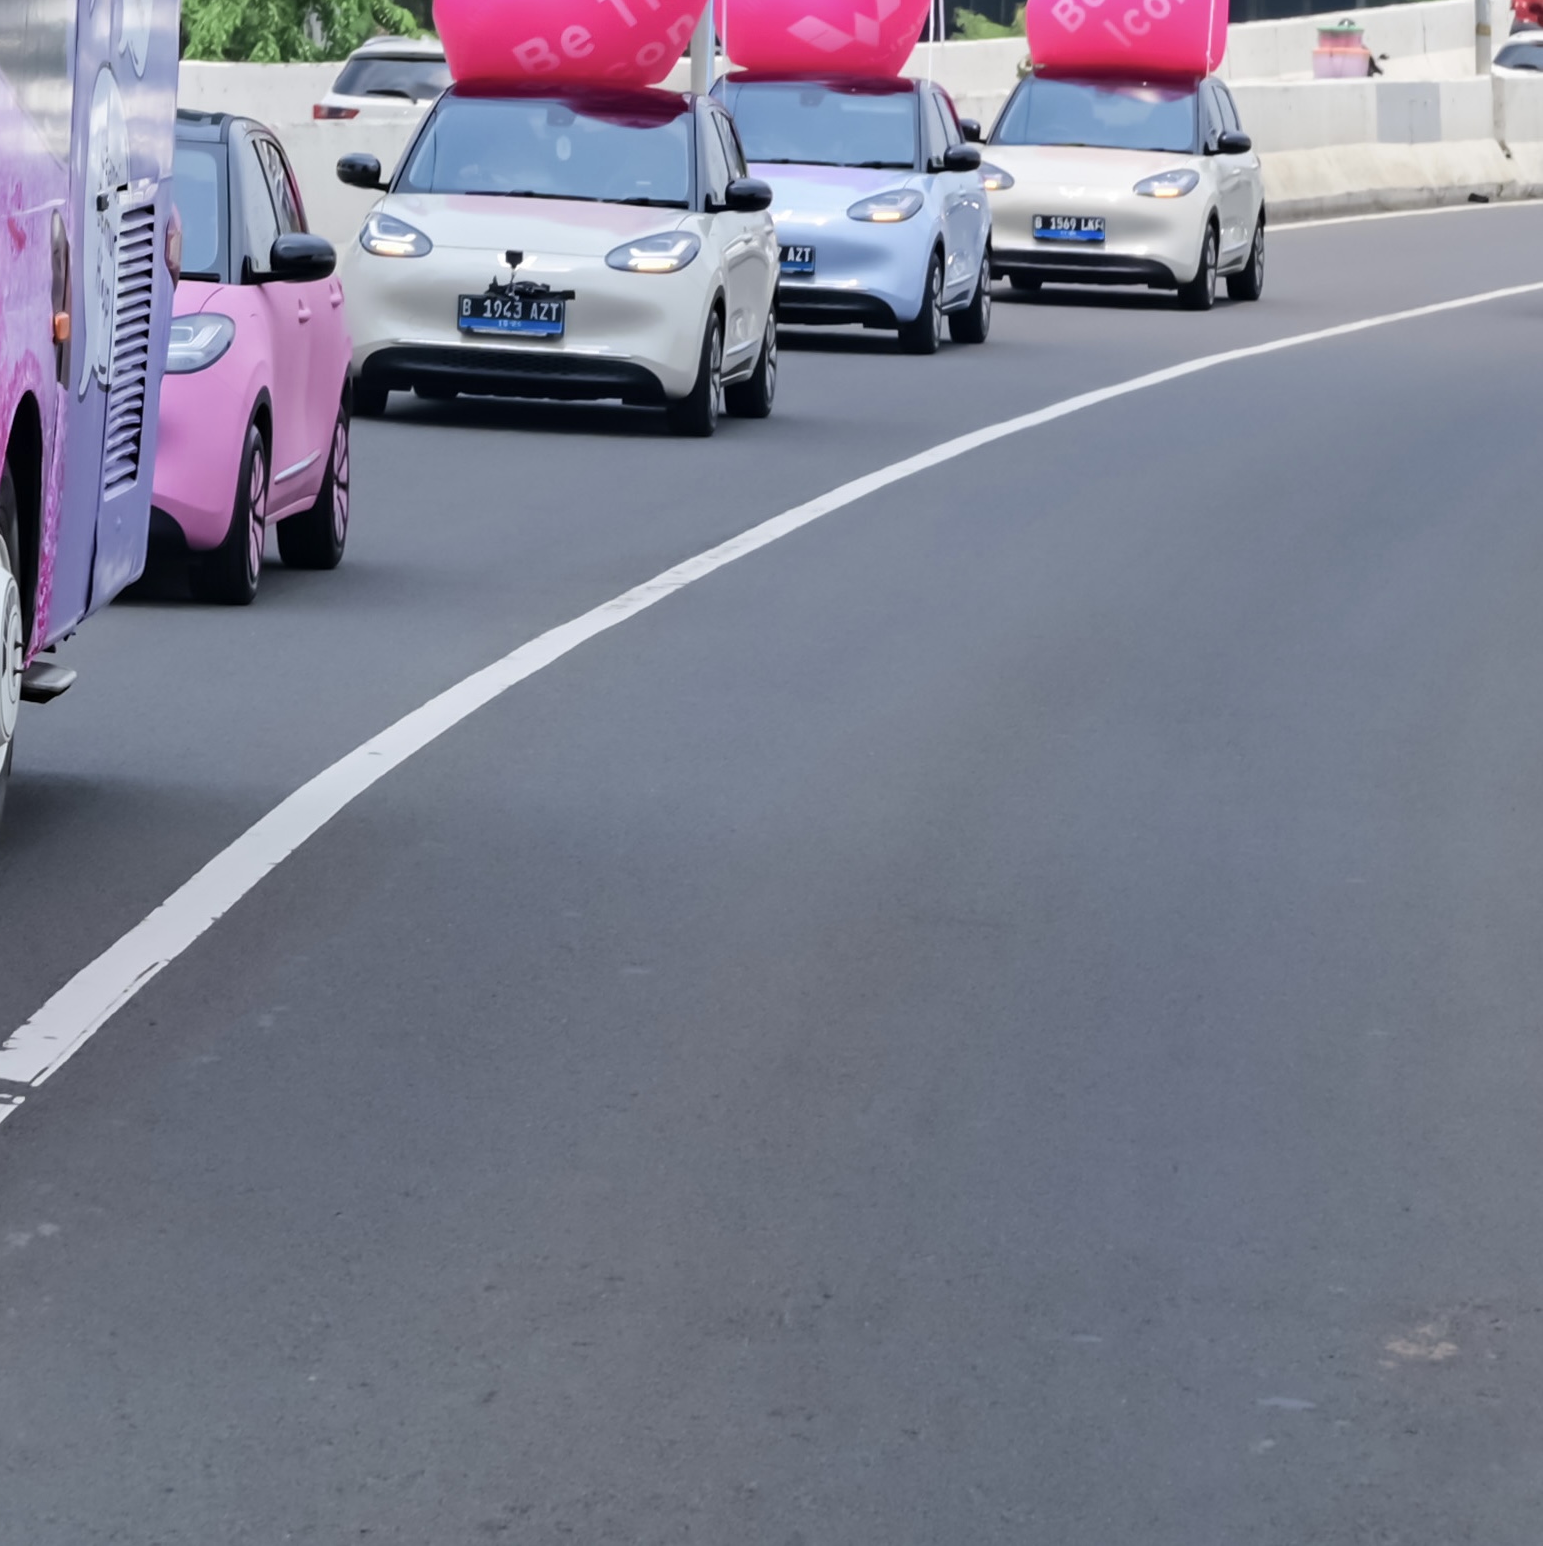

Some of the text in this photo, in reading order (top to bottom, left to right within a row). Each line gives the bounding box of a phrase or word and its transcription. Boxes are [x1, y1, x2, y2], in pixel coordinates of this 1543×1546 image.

[511, 24, 595, 75] Be
[787, 246, 811, 262] AZT
[462, 298, 472, 316] B
[530, 302, 560, 321] AZT
